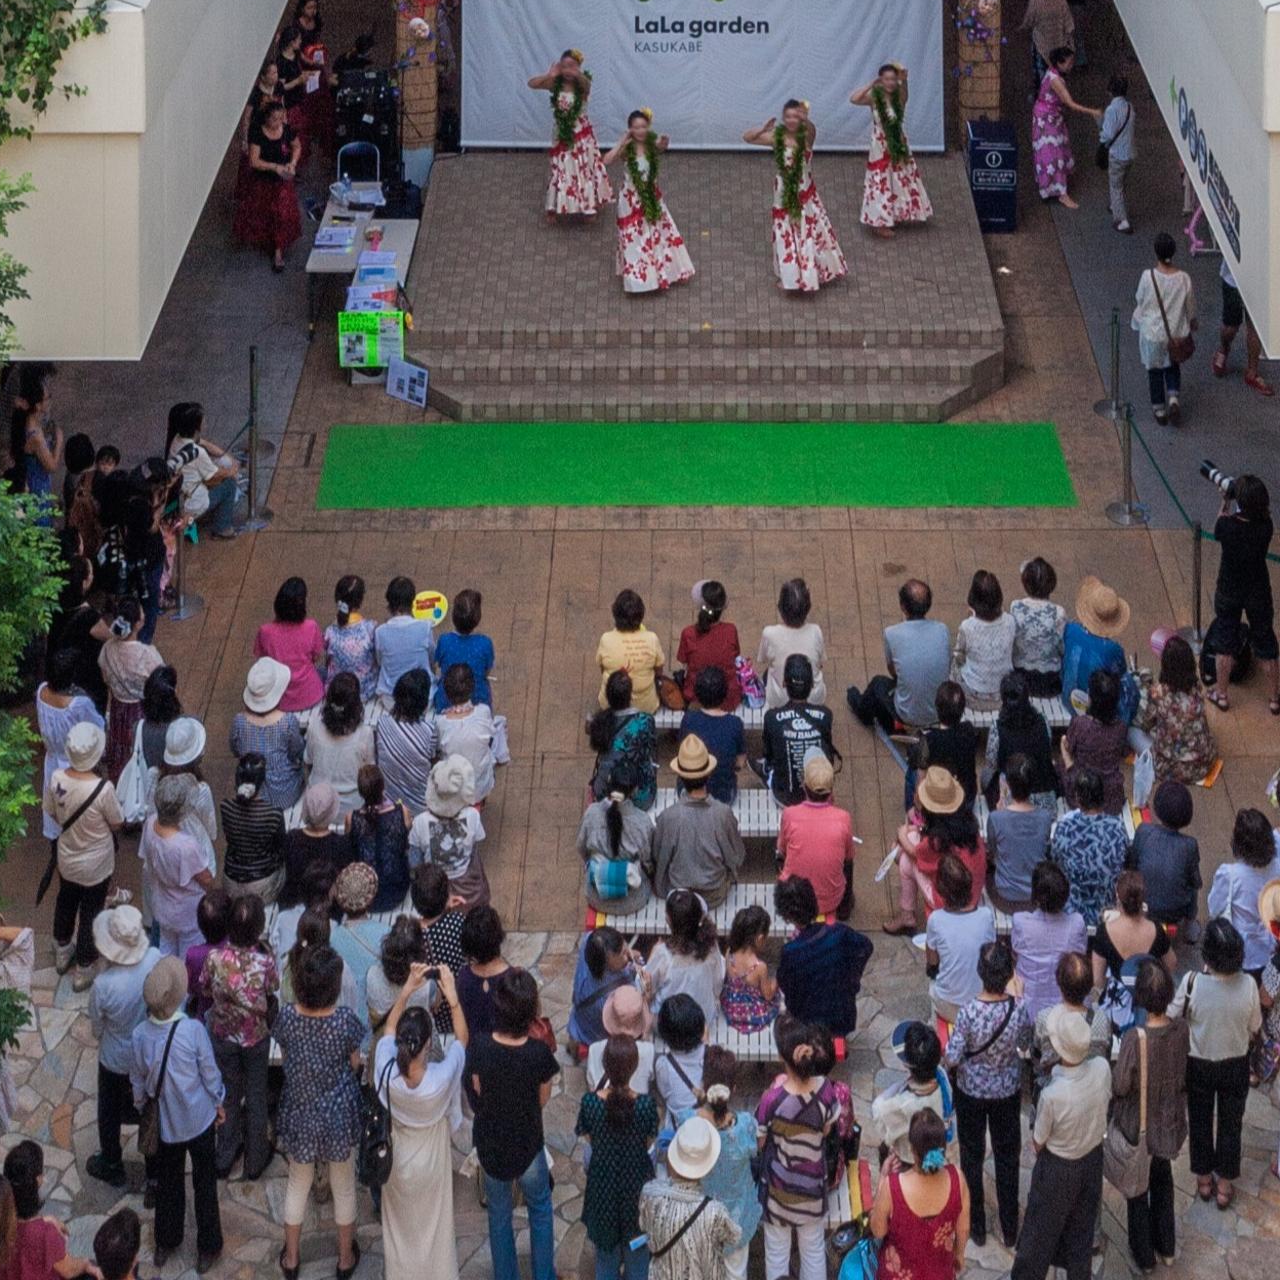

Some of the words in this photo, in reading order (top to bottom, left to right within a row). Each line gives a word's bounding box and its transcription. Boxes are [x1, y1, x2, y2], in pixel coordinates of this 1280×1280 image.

[635, 15, 685, 34] LaLa
[688, 15, 770, 39] garden
[634, 41, 703, 53] KASUKABE
